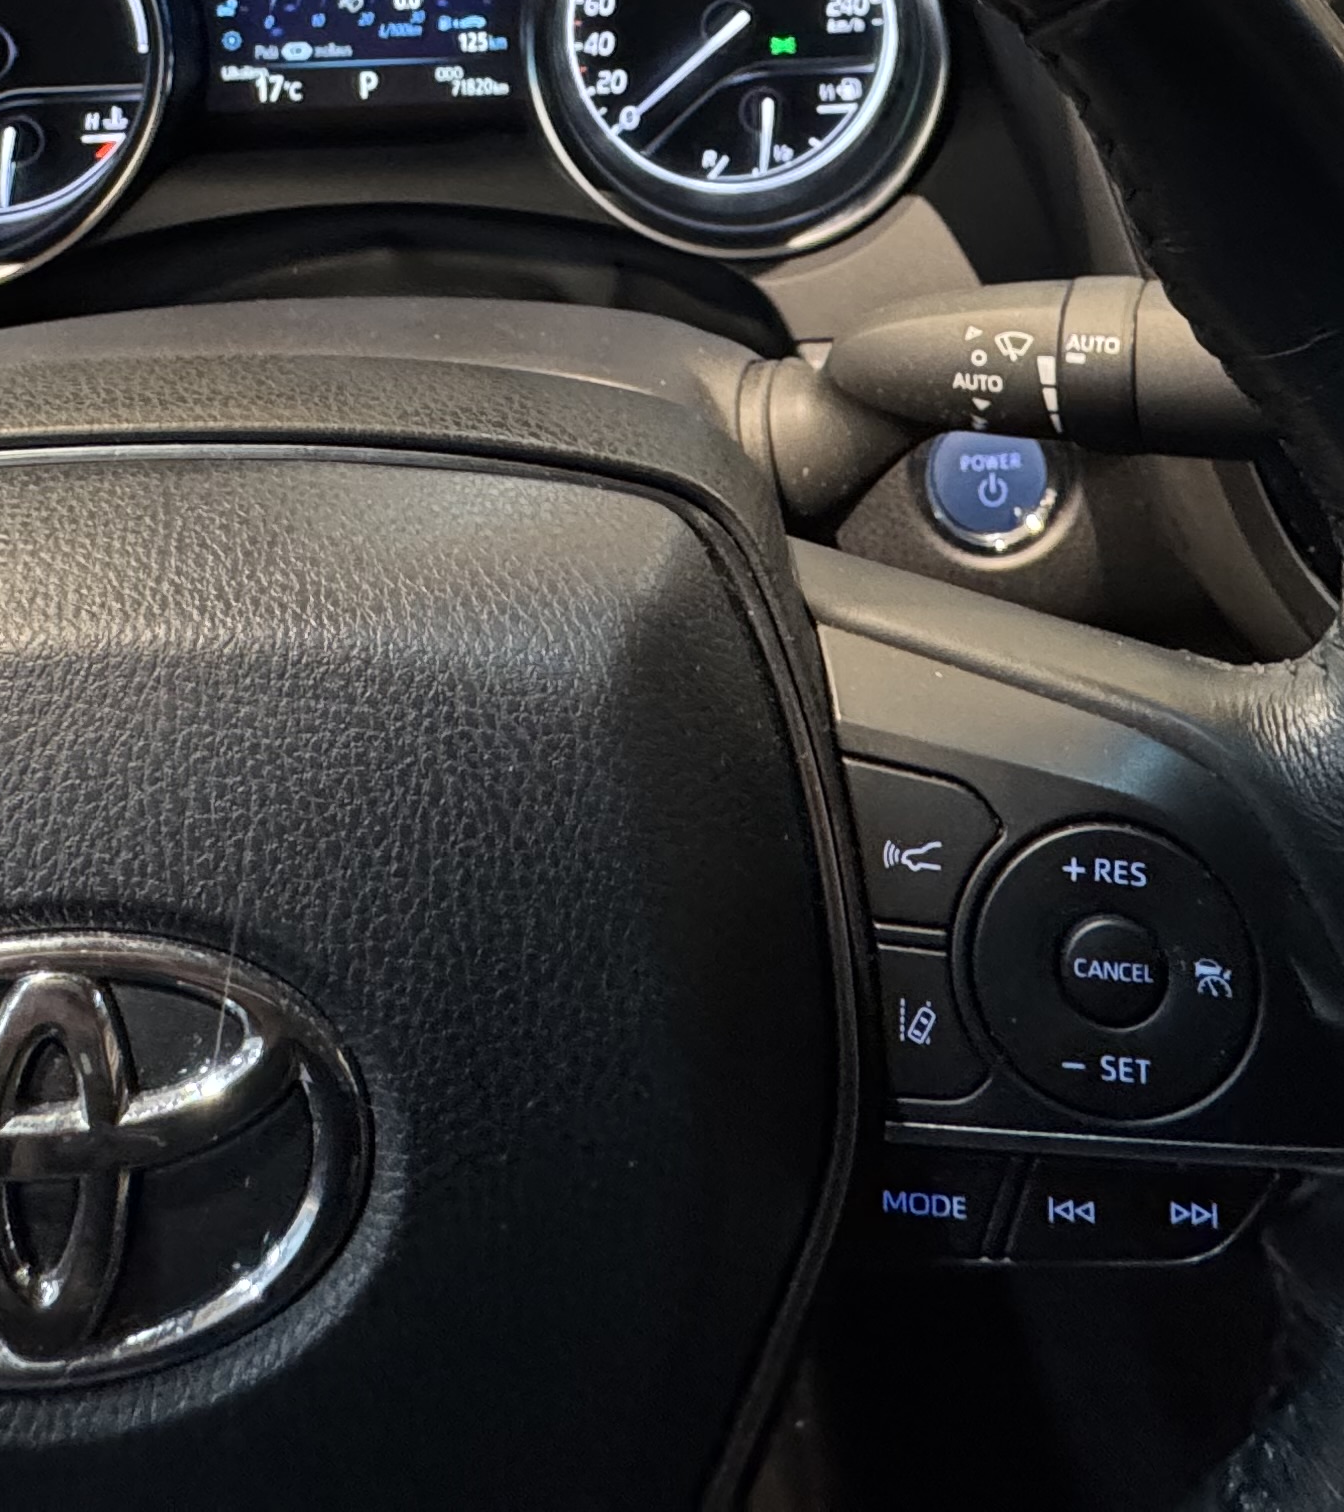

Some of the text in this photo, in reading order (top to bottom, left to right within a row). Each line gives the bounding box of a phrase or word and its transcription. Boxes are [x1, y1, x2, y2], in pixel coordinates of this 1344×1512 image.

[458, 31, 489, 54] 125
[583, 31, 616, 57] 40
[358, 71, 379, 99] P
[596, 70, 628, 95] 20
[1065, 334, 1120, 354] AUTO
[952, 372, 1003, 393] AUTO
[959, 451, 1022, 472] POWER
[1094, 858, 1148, 888] RES
[1073, 958, 1154, 984] CANCEL
[1100, 1055, 1151, 1084] SET
[882, 1189, 968, 1220] MODE
